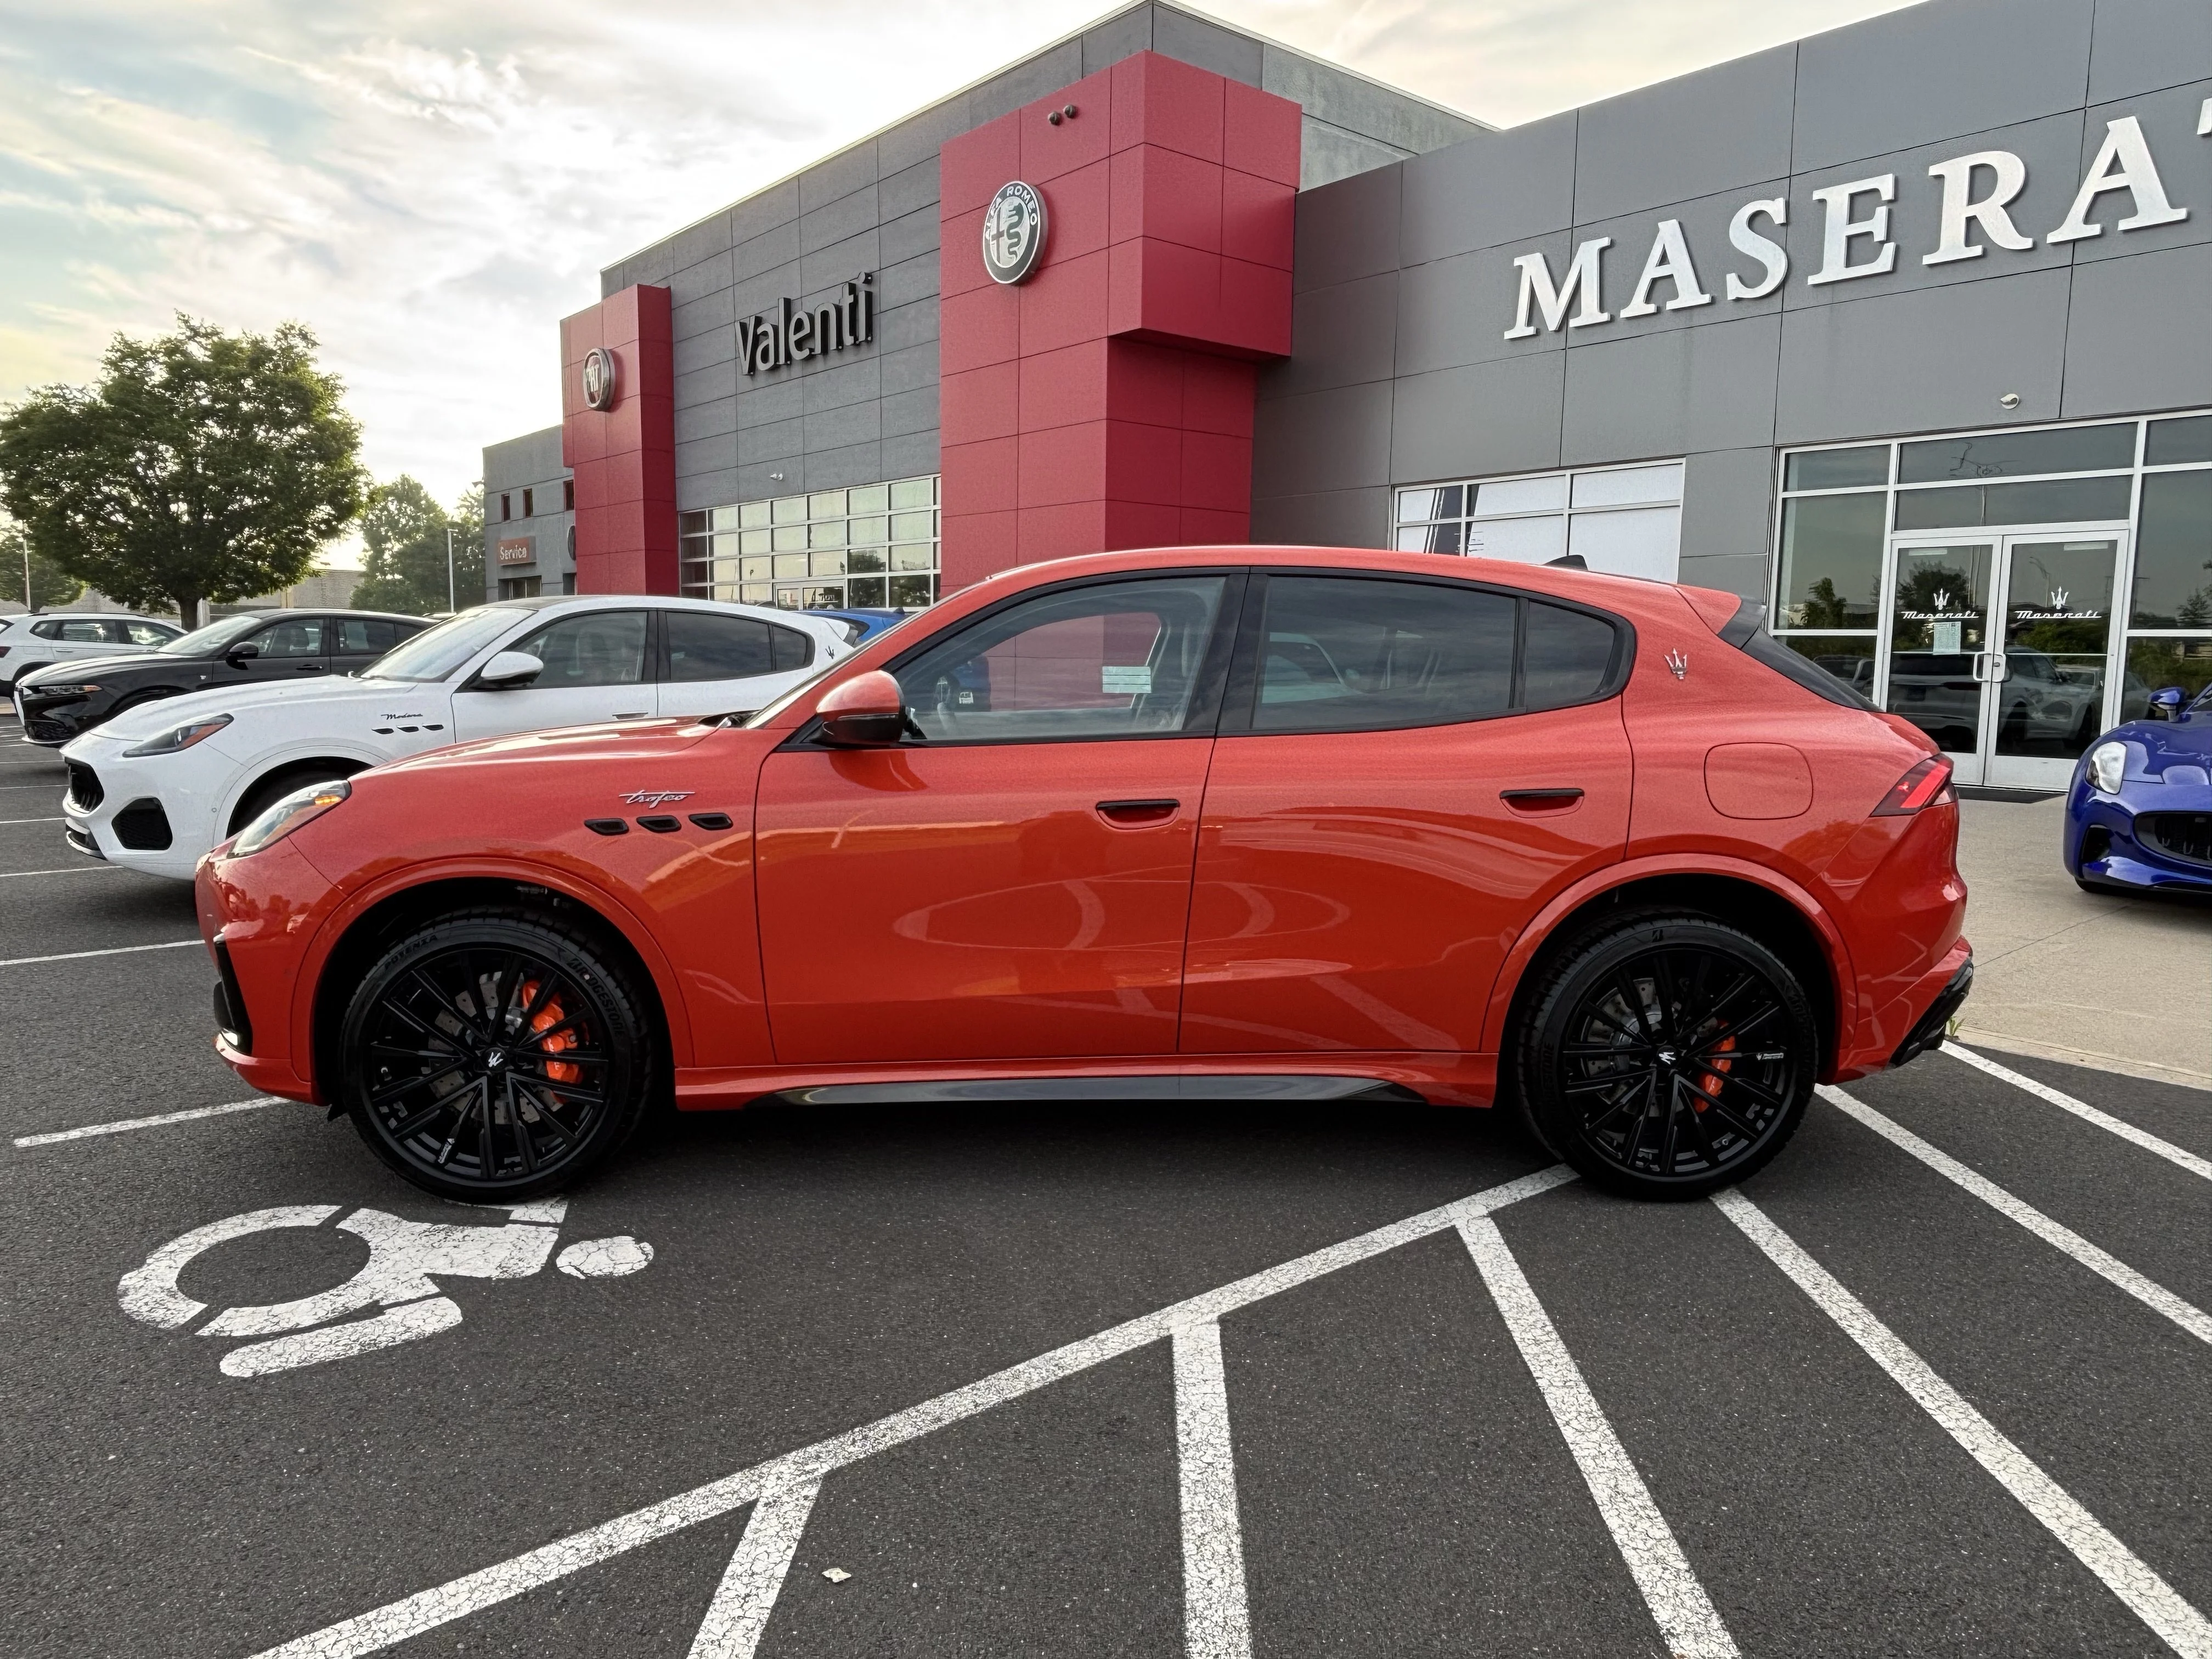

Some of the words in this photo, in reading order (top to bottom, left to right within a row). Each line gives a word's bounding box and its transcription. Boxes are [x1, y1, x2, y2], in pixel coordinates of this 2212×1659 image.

[1007, 185, 1037, 225] ROMEO
[1504, 98, 2212, 341] MASERA
[735, 272, 873, 376] Valenti
[1900, 611, 1979, 619] Maserati
[2014, 610, 2102, 619] Maserati
